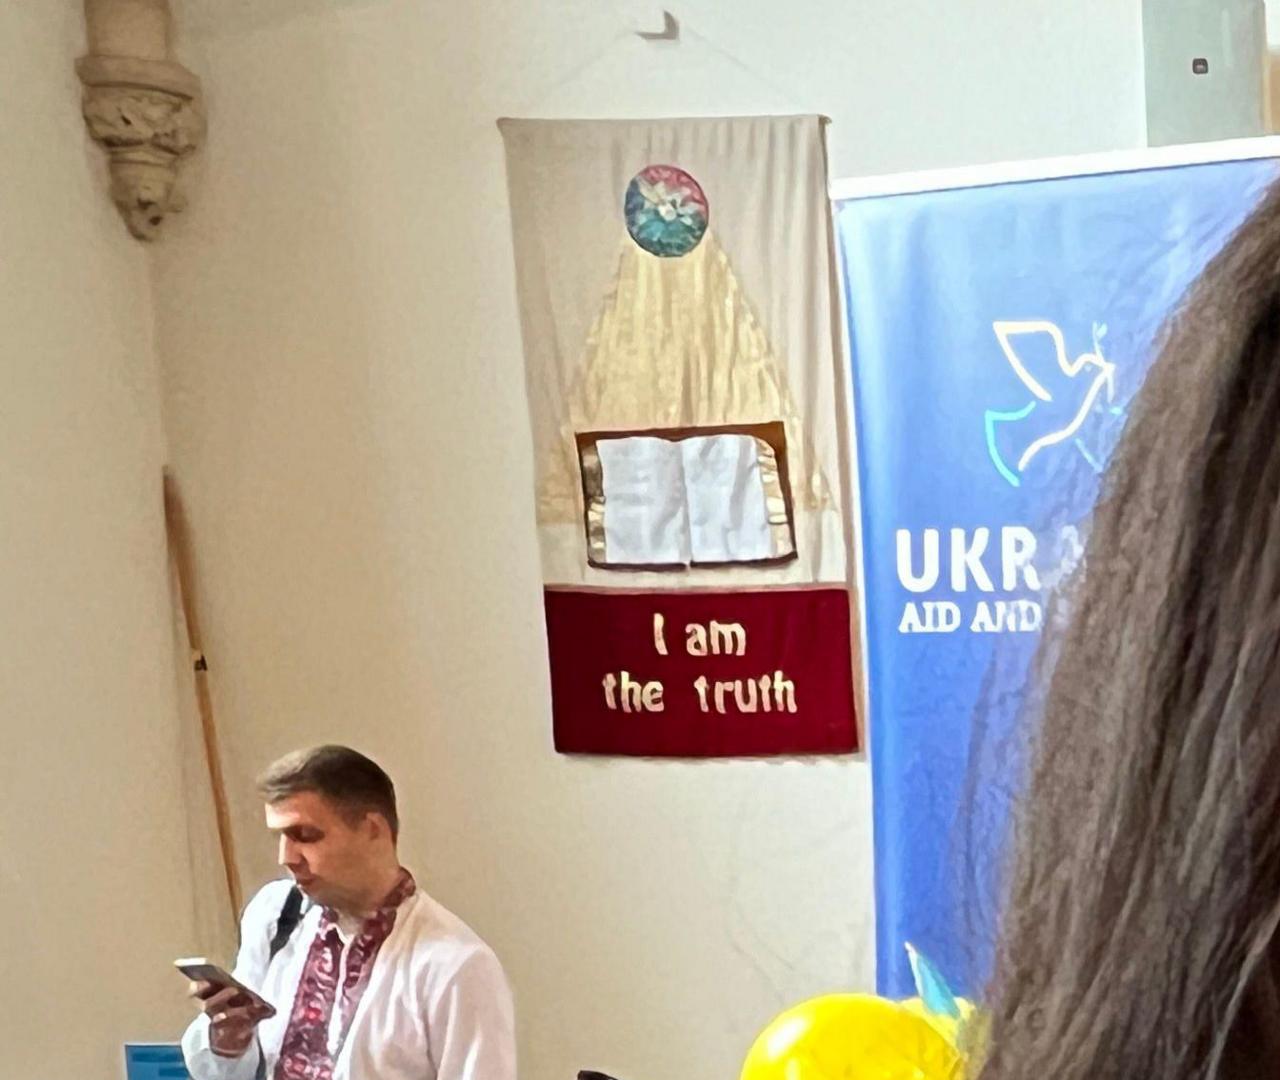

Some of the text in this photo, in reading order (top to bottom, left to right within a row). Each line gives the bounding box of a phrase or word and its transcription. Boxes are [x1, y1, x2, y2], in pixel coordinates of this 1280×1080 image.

[653, 613, 746, 656] I am
[898, 599, 1043, 633] AID AND
[602, 670, 797, 714] the truth
